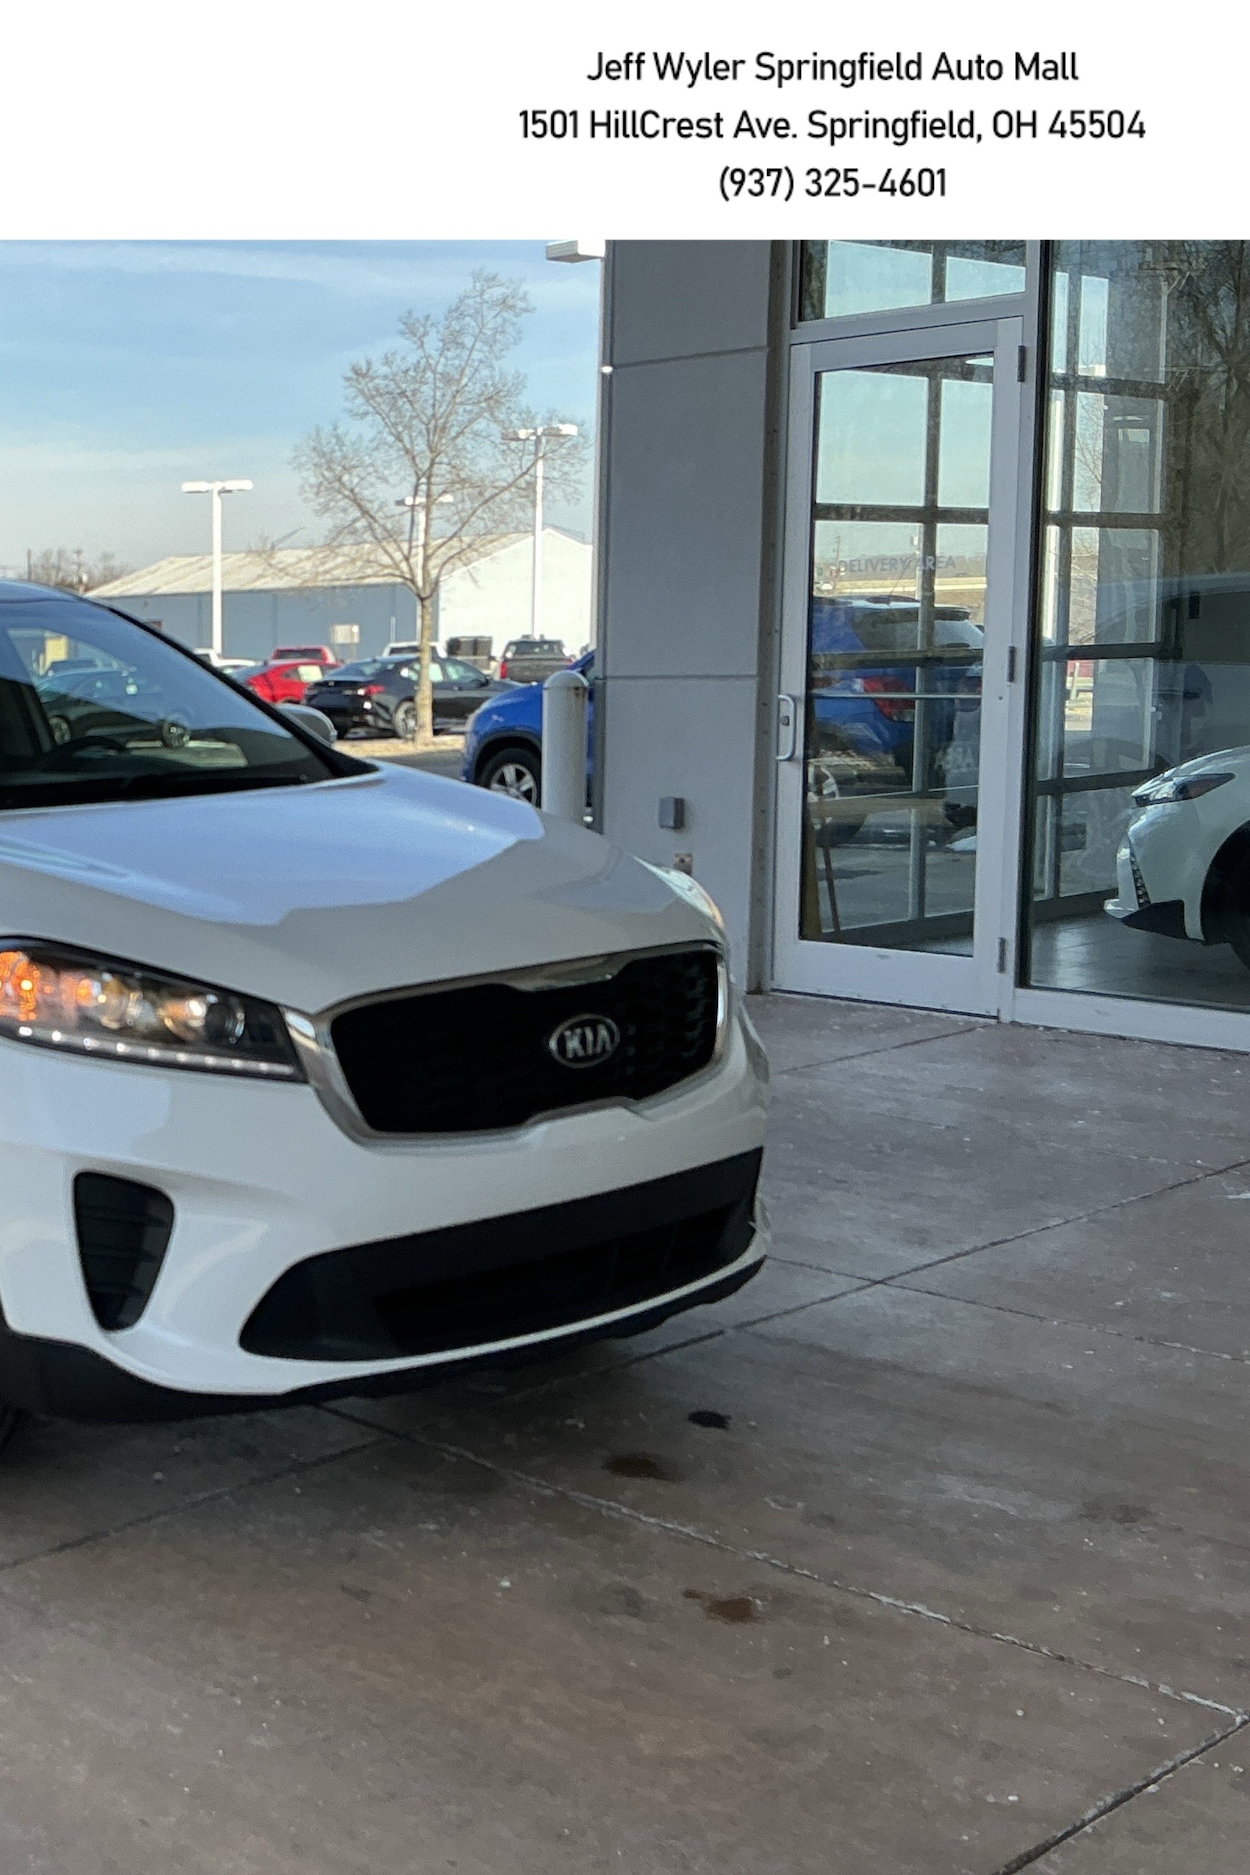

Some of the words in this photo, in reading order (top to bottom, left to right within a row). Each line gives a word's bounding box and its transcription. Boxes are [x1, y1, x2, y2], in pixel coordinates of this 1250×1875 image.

[838, 557, 911, 573] DELIVERY
[916, 555, 956, 570] AREA
[563, 1023, 613, 1059] KIA
